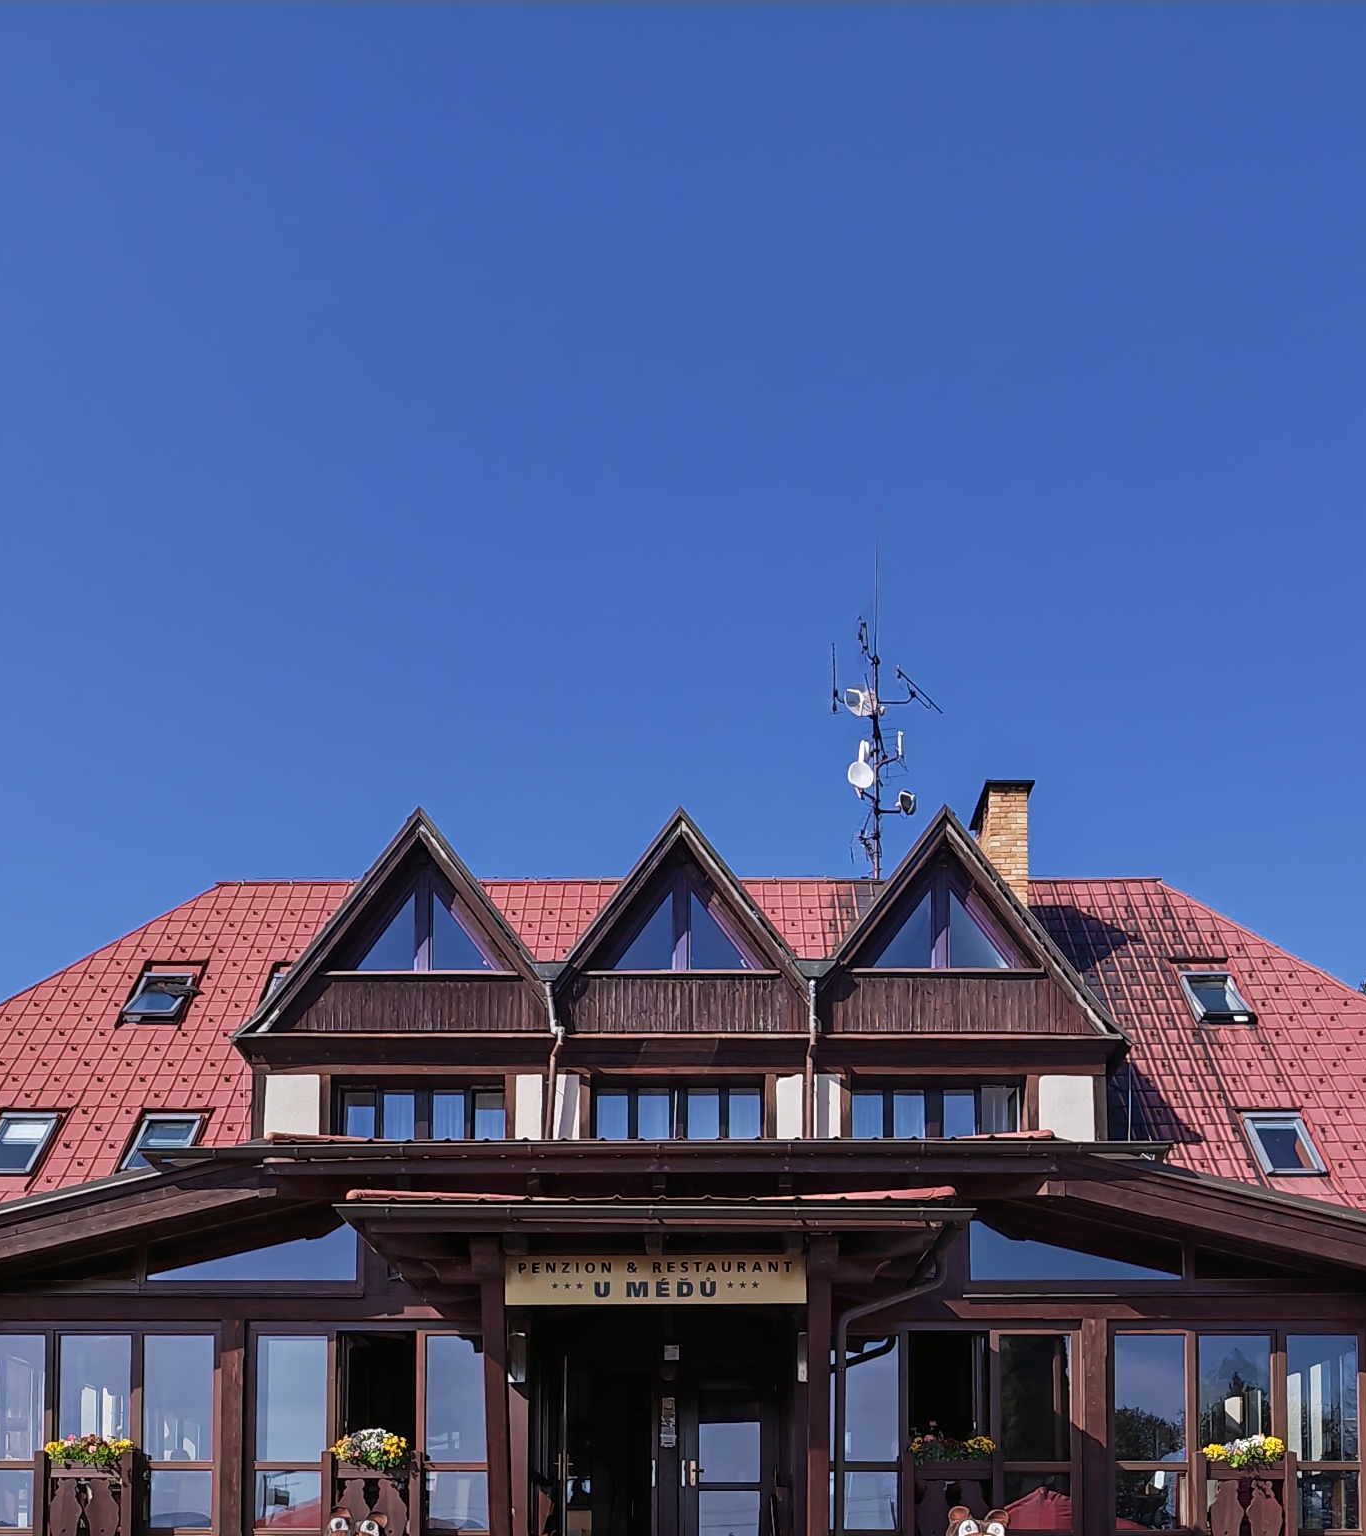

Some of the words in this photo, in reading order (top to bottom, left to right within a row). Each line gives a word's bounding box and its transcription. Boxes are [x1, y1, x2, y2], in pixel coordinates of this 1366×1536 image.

[517, 1261, 613, 1274] PENZION
[626, 1261, 638, 1274] &
[651, 1260, 793, 1274] RESTAURANT
[593, 1280, 611, 1298] U
